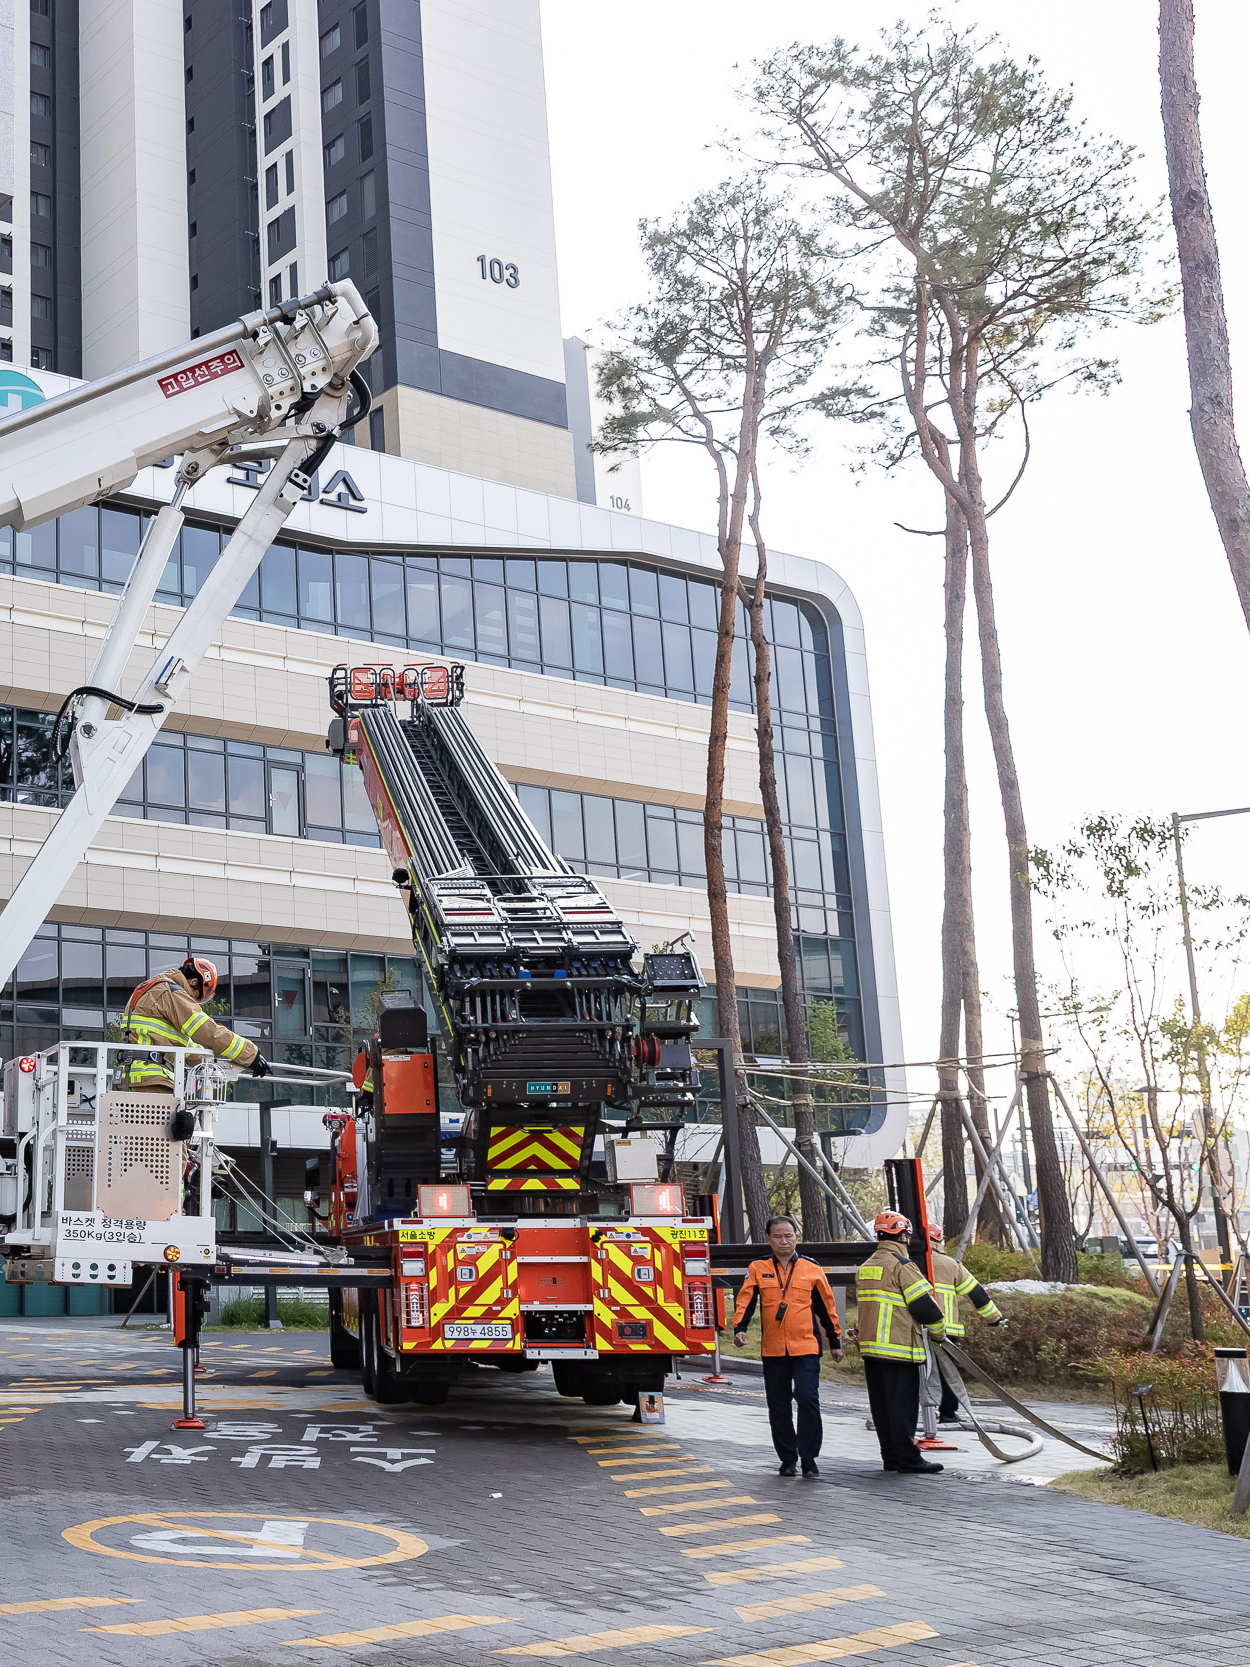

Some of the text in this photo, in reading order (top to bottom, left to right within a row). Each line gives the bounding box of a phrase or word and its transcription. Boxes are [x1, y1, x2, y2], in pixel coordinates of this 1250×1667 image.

[476, 254, 520, 289] 103
[162, 352, 242, 395] 고압선주의
[609, 494, 632, 512] 104
[61, 1216, 147, 1231] 바스켓 정격용량
[64, 1228, 142, 1243] 350Kg(3인승)
[400, 1230, 436, 1241] 서울소방
[670, 1229, 707, 1240] 광진11호
[448, 1326, 508, 1337] 998누 4855
[123, 1441, 437, 1472] 소방차
